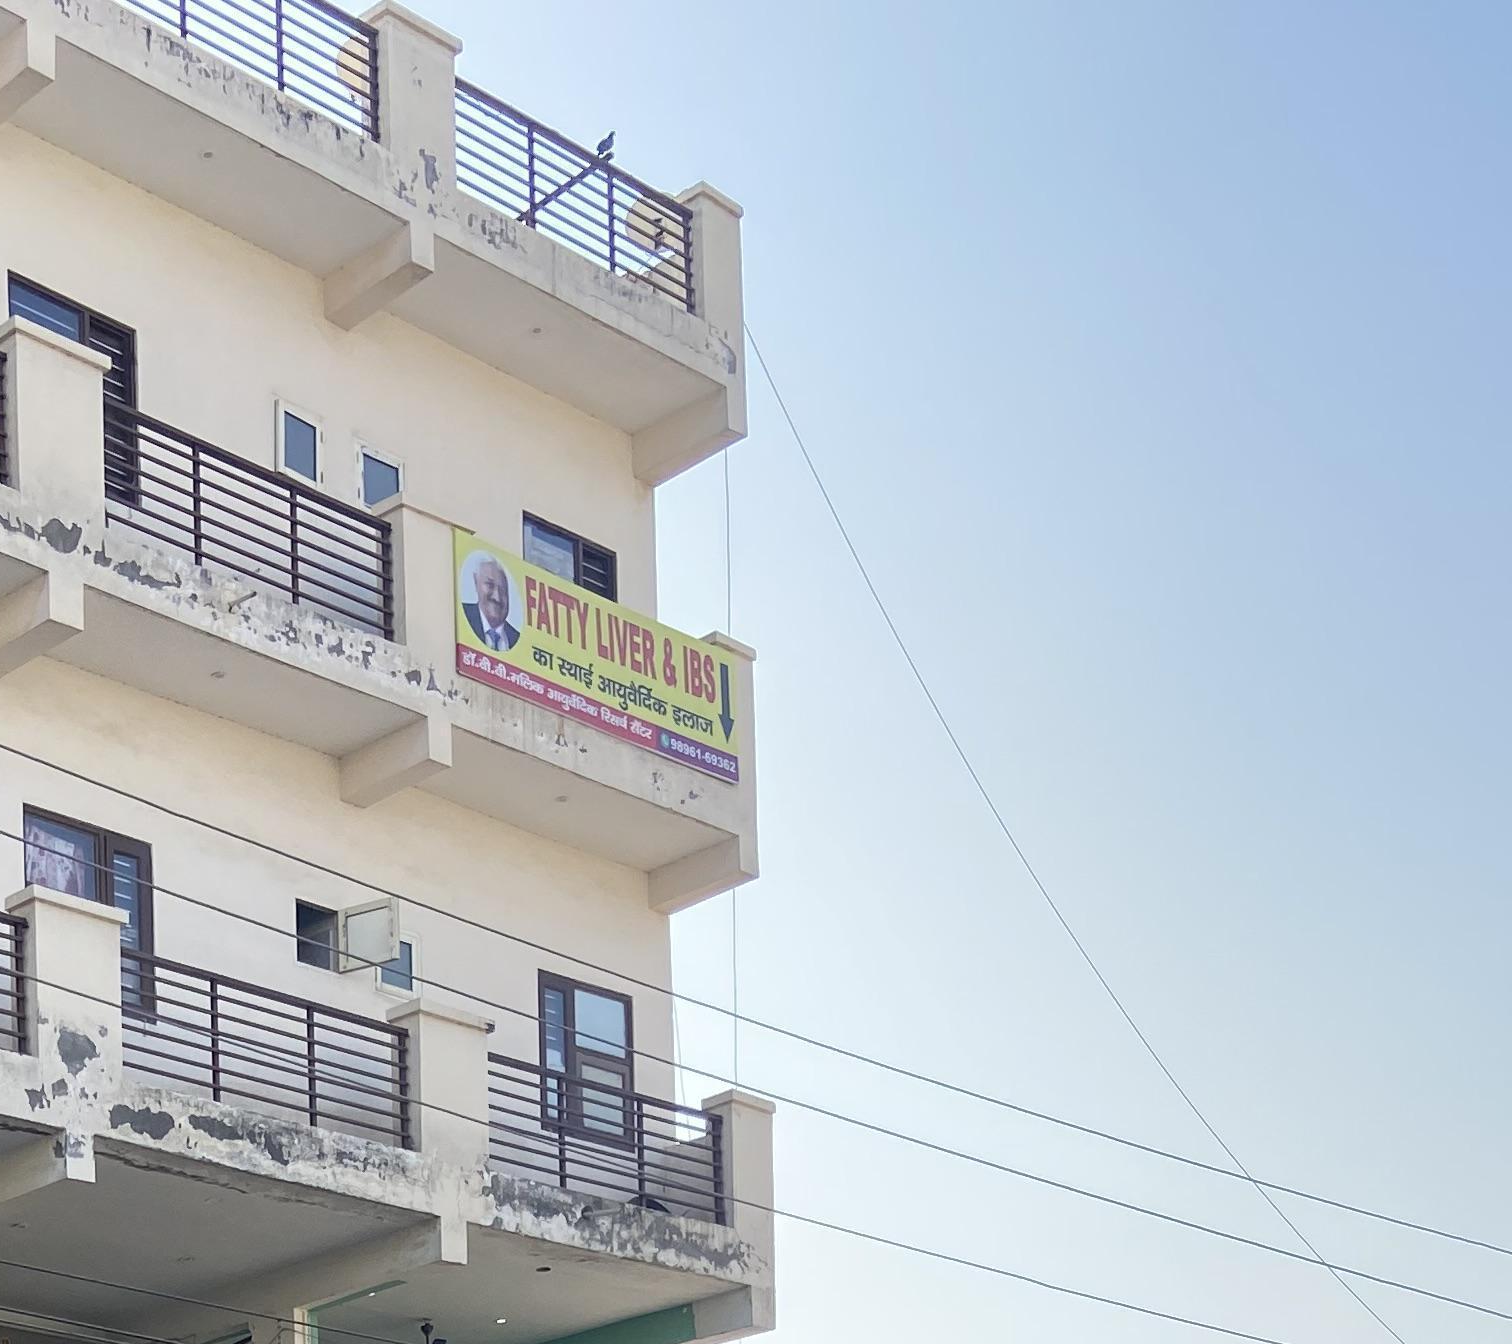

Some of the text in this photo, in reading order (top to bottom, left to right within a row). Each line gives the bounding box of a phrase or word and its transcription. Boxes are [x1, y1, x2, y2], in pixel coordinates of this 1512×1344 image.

[525, 576, 717, 704] FATTY LIVER & IBS
[531, 646, 554, 670] का
[671, 706, 714, 737] इलाज
